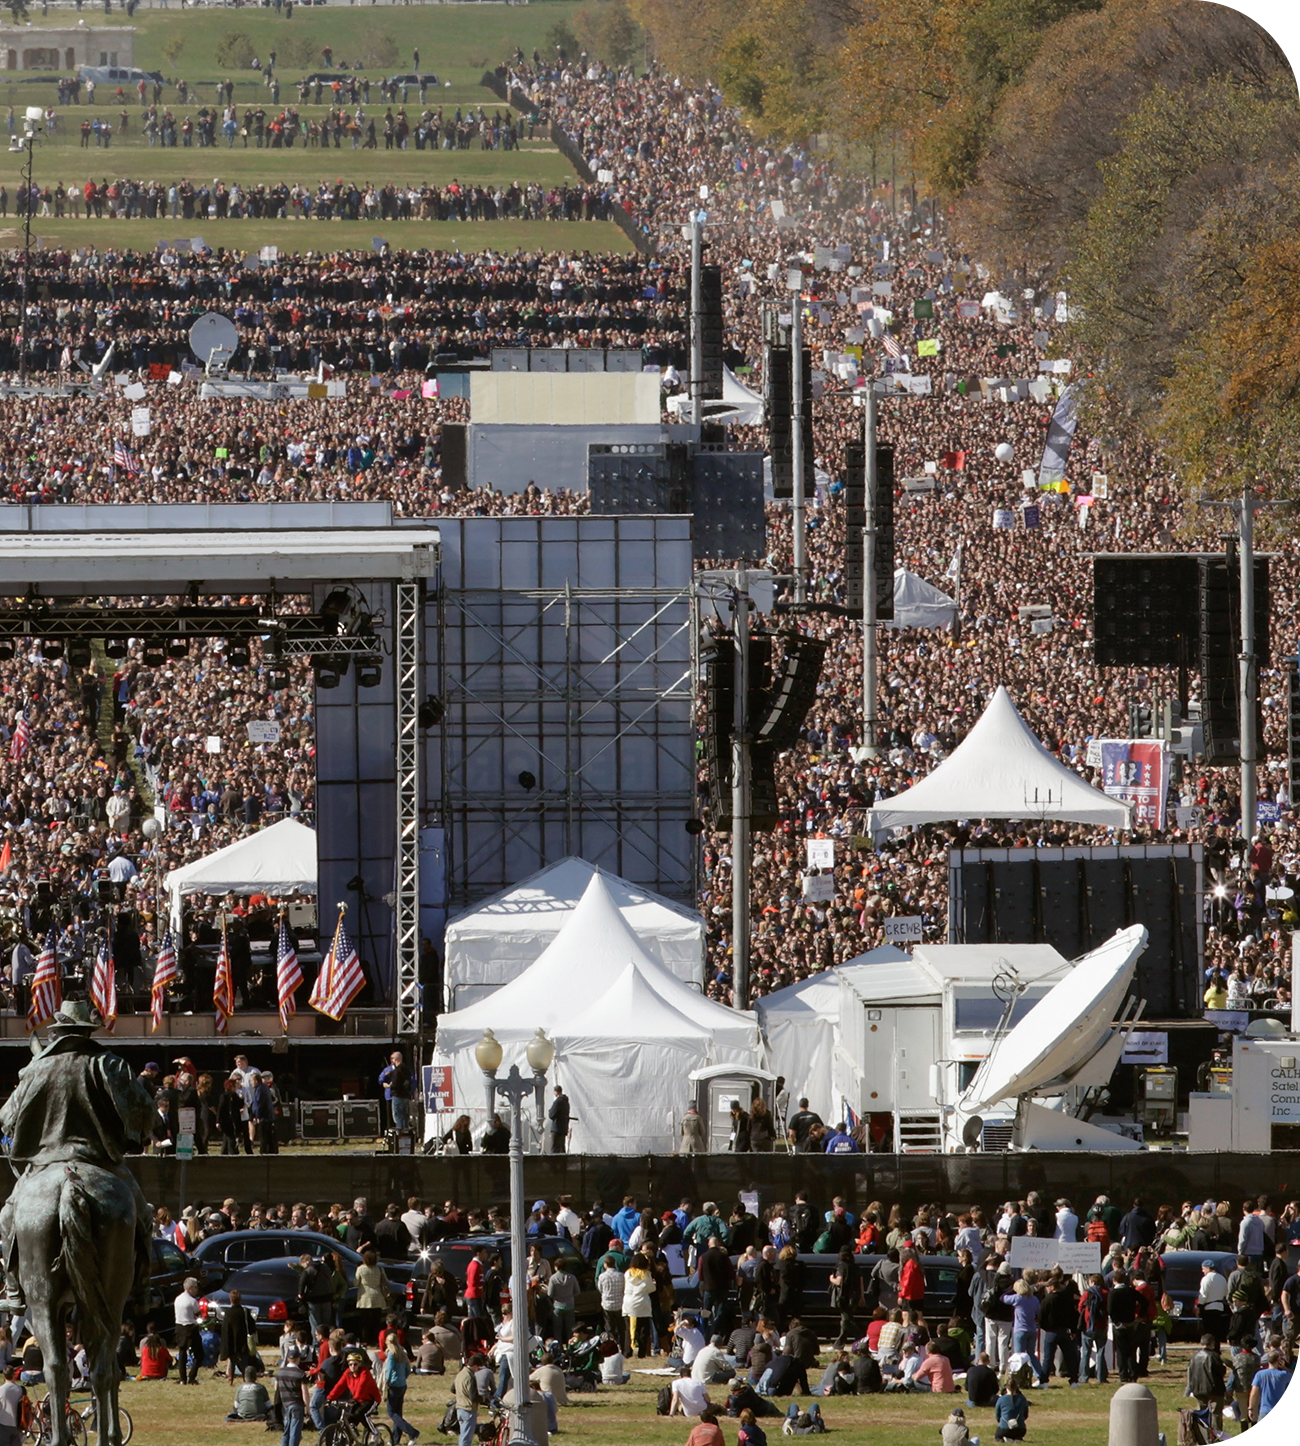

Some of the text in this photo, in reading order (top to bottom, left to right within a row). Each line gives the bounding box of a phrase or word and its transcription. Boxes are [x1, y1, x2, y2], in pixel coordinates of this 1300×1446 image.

[1137, 795, 1150, 804] TO
[886, 922, 921, 936] CREWB
[1021, 1241, 1050, 1249] SANITY
